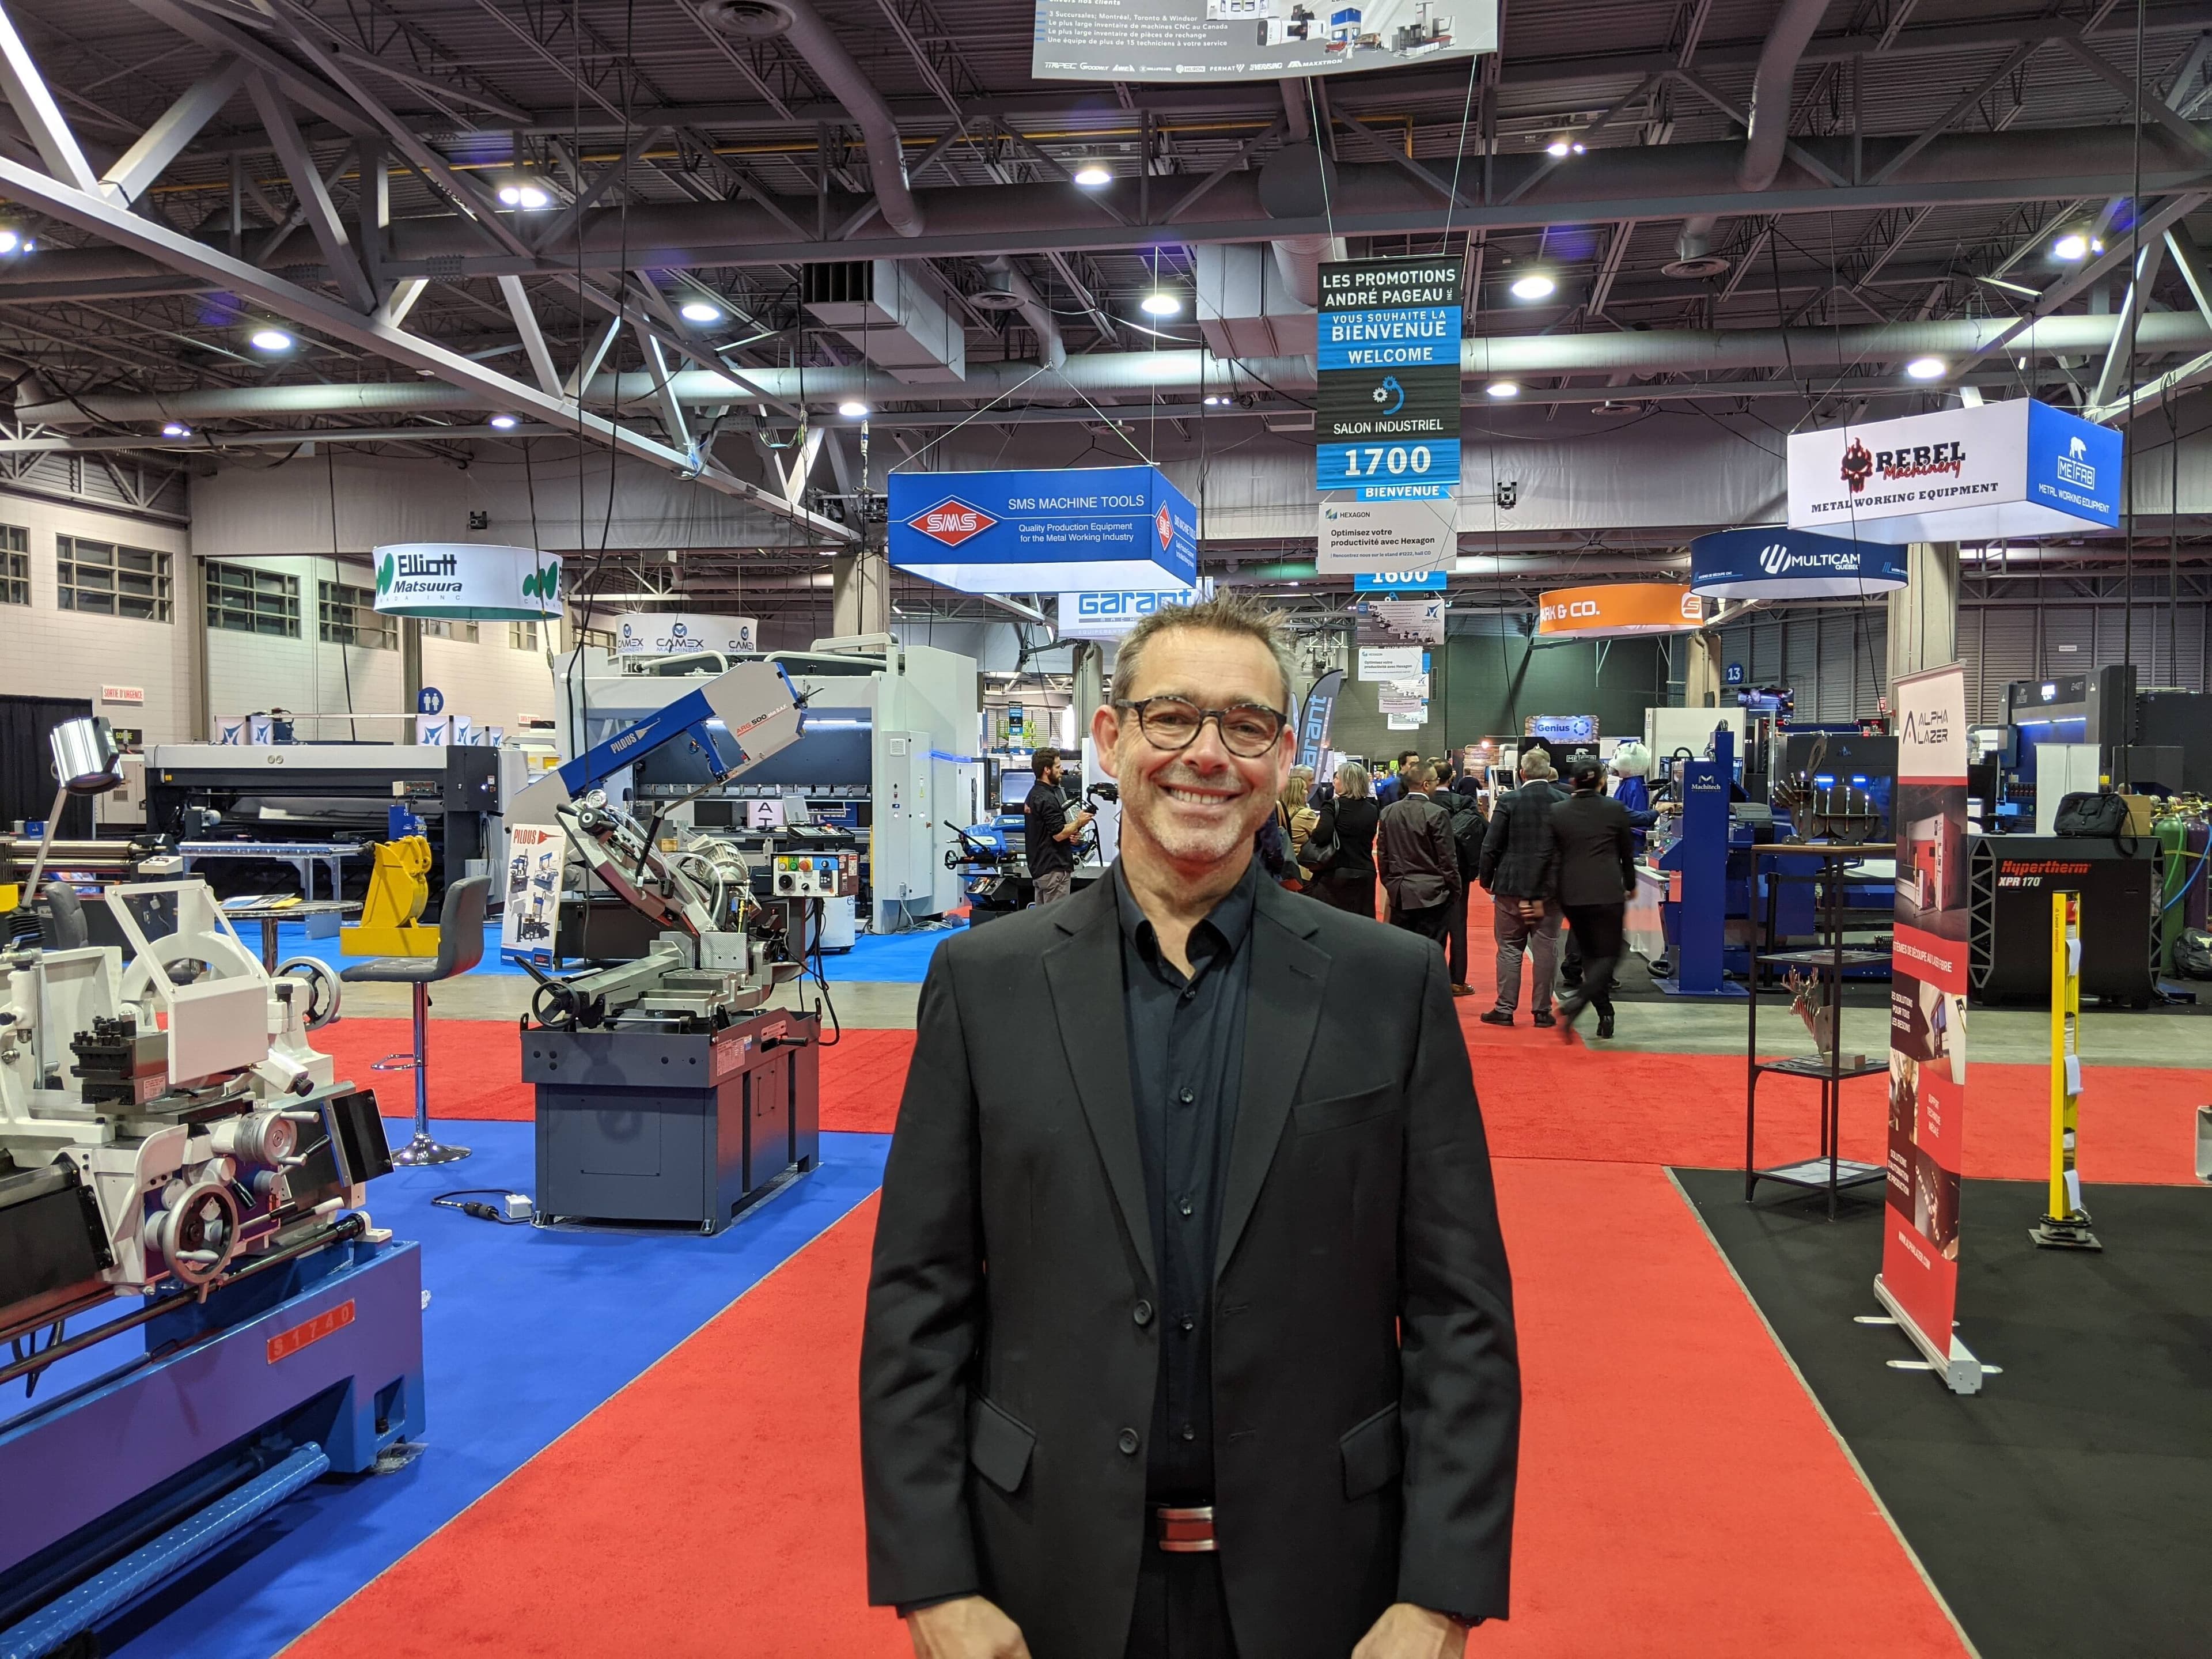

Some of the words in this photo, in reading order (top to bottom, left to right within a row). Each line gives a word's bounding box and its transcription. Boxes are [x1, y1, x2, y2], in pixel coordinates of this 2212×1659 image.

[1302, 59, 1343, 67] MAXXTRON
[1323, 275, 1350, 288] LES
[1355, 269, 1455, 286] PROMOTIONS
[1325, 288, 1377, 306] ANDRÉ
[1382, 288, 1442, 304] PAGEAU
[1332, 315, 1362, 324] VOUS
[1368, 311, 1426, 322] SOUHAITE
[1431, 310, 1446, 319] LA
[1332, 321, 1446, 342] BIENVENUE
[1348, 347, 1433, 364] WELCOME
[1334, 422, 1371, 434] SALON
[1376, 419, 1444, 433] INDUSTRIEL
[1345, 446, 1431, 476] 1700
[1876, 441, 1965, 472] REBEL
[1883, 460, 1961, 480] Machinery
[1366, 486, 1439, 497] BIENVENUE
[1811, 500, 1852, 513] METAL
[1854, 493, 1915, 507] WORKING
[1919, 482, 1999, 500] EQUIPMENT
[2039, 483, 2058, 497] METAL
[2059, 489, 2081, 505] WORKING
[2082, 497, 2110, 513] EQUIPMENT
[1008, 499, 1035, 510] SMS
[1039, 497, 1097, 509] MACHINE
[1101, 495, 1145, 507] TOOLS
[926, 513, 977, 532] SMS
[1018, 524, 1045, 533] Quality
[1047, 523, 1088, 532] Production
[1090, 522, 1132, 532] Equipment
[1069, 533, 1100, 542] Working
[1103, 533, 1134, 542] Industry
[1331, 529, 1370, 538] Optimisez
[1331, 539, 1379, 547] productivité
[1401, 537, 1435, 546] Hexagon
[397, 554, 457, 577] Elliott
[1791, 554, 1860, 567] MULTICAM
[393, 581, 463, 593] Matsuura
[1558, 604, 1567, 619] &
[1570, 601, 1600, 617] CO.
[618, 638, 643, 648] CAMEX
[657, 639, 704, 648] CAMEX
[1728, 668, 1740, 680] 13
[104, 688, 118, 698] SORTIE
[120, 690, 143, 699] D'URGENCE
[737, 722, 751, 733] ARG
[751, 714, 767, 725] 500
[1919, 709, 1948, 726] ALPHA
[1302, 695, 1327, 767] arant
[1918, 729, 1948, 744] LAZER
[610, 733, 637, 754] PILOUS
[513, 829, 536, 844] PILOUS
[2001, 860, 2089, 876] Hypertherm
[1998, 877, 2021, 887] XPR
[1896, 993, 1912, 1008] SOLUTIONS
[1892, 1004, 1902, 1016] POUR
[1902, 1008, 1910, 1019] TOUS
[1897, 1019, 1910, 1033] BESOINS
